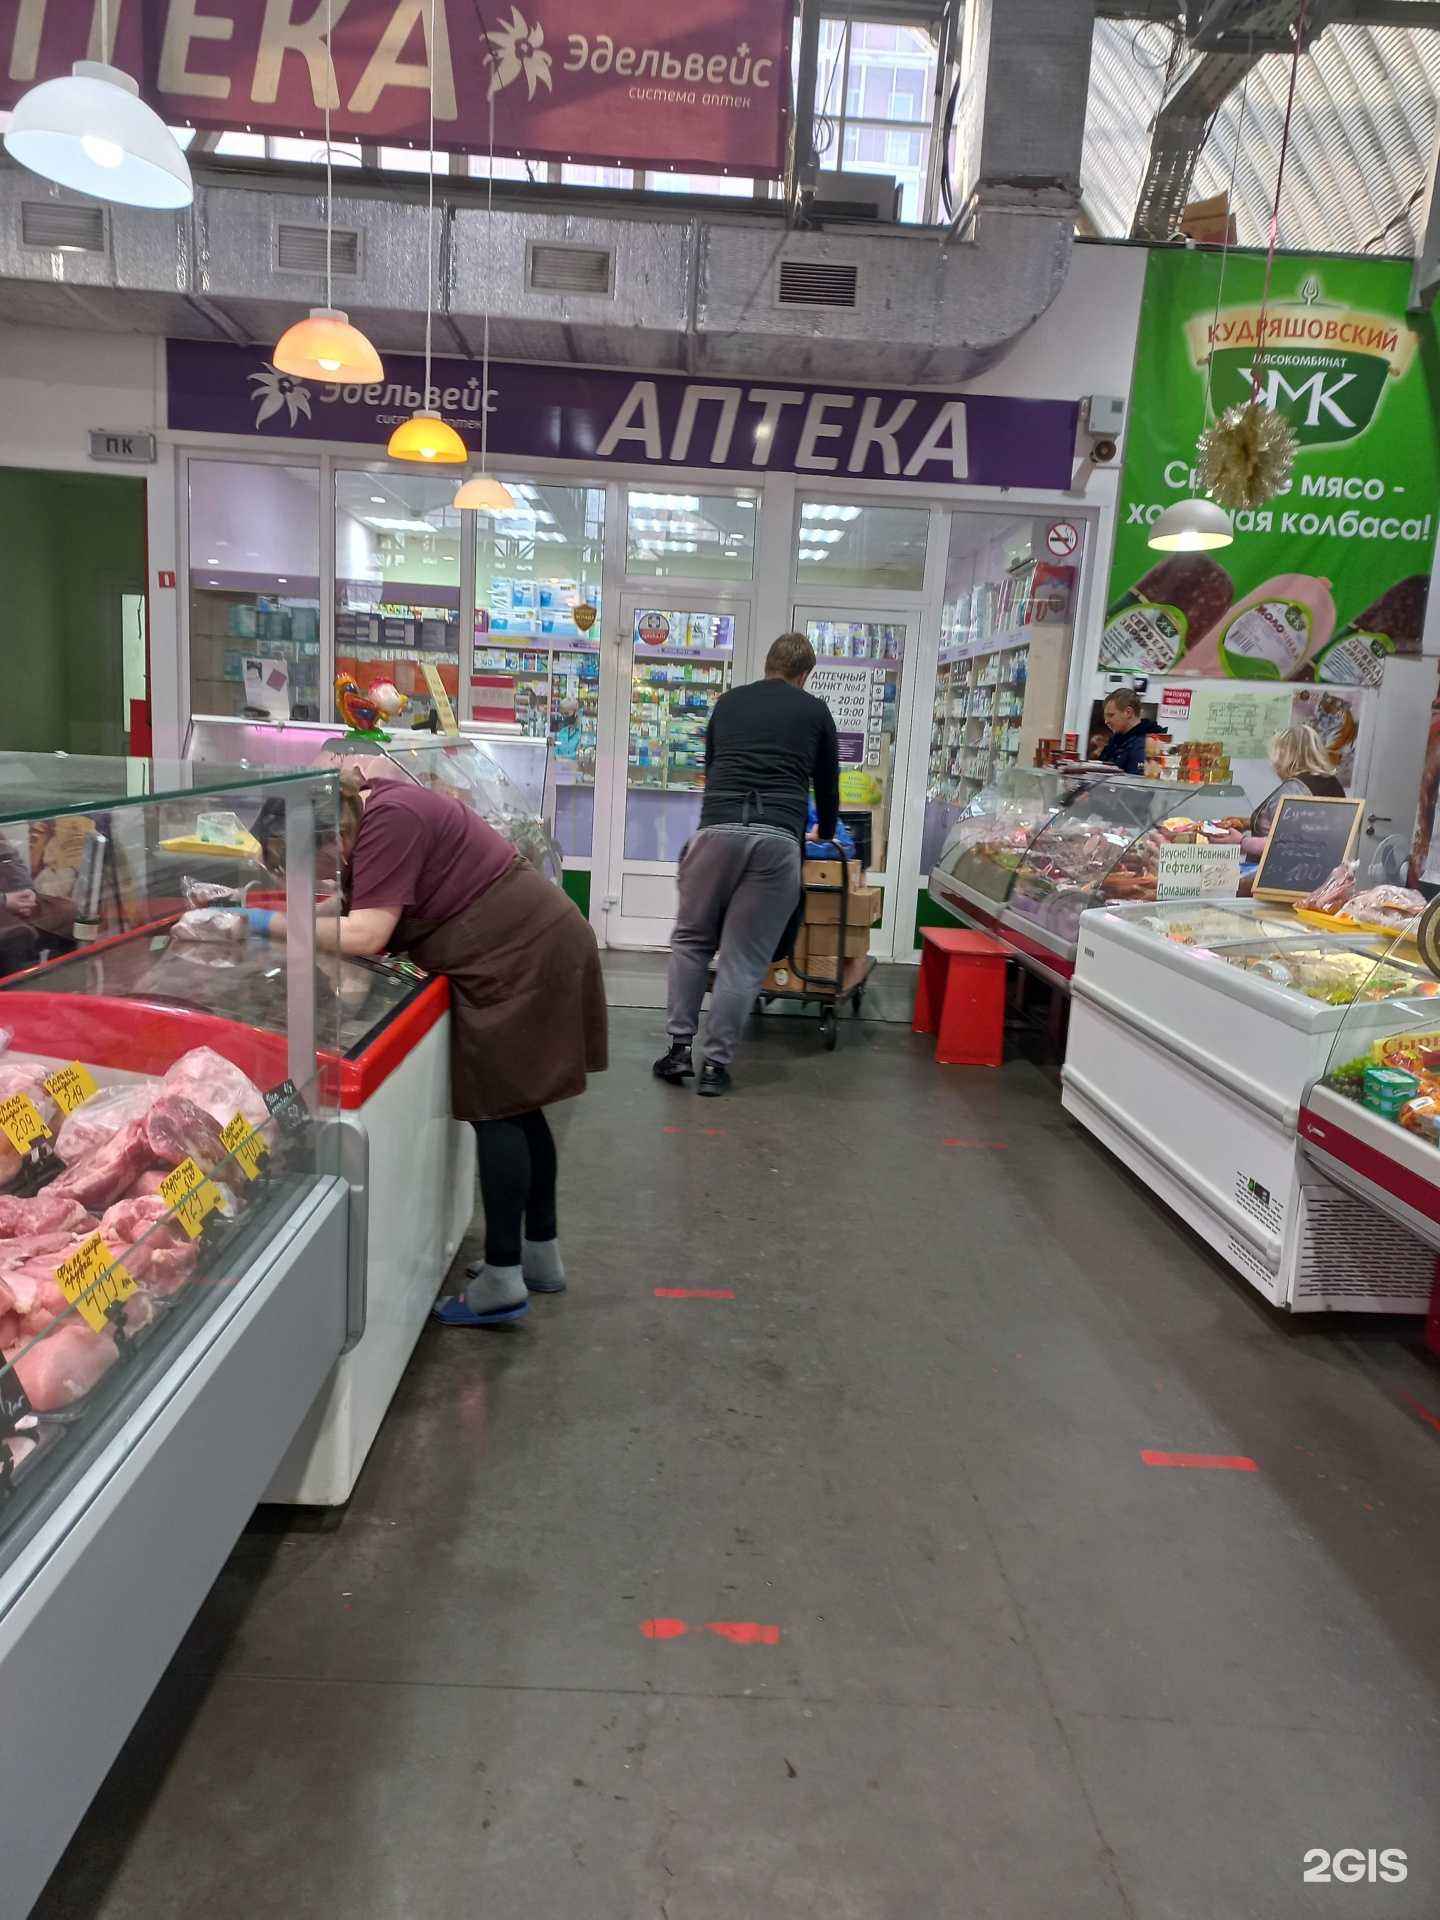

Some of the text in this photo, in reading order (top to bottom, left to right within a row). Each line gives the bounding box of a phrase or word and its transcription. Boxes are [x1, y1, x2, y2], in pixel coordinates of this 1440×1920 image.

[563, 33, 773, 88] Эдельвейс
[627, 86, 752, 109] система аптек
[1208, 318, 1399, 352] КУДРЯШОВСКИЙ
[596, 381, 969, 480] АПТЕКА
[106, 437, 133, 454] ПК
[1301, 475, 1384, 500] мясо
[1281, 511, 1431, 541] колбаса!
[810, 681, 842, 691] ПУНКТ
[811, 671, 866, 681] АПТЕЧНЫЙ
[838, 696, 865, 705] 20:00
[838, 707, 864, 717] 19:00
[1161, 861, 1201, 875] Тефтели
[1158, 884, 1200, 898] Домашние
[10, 1113, 36, 1142] 209
